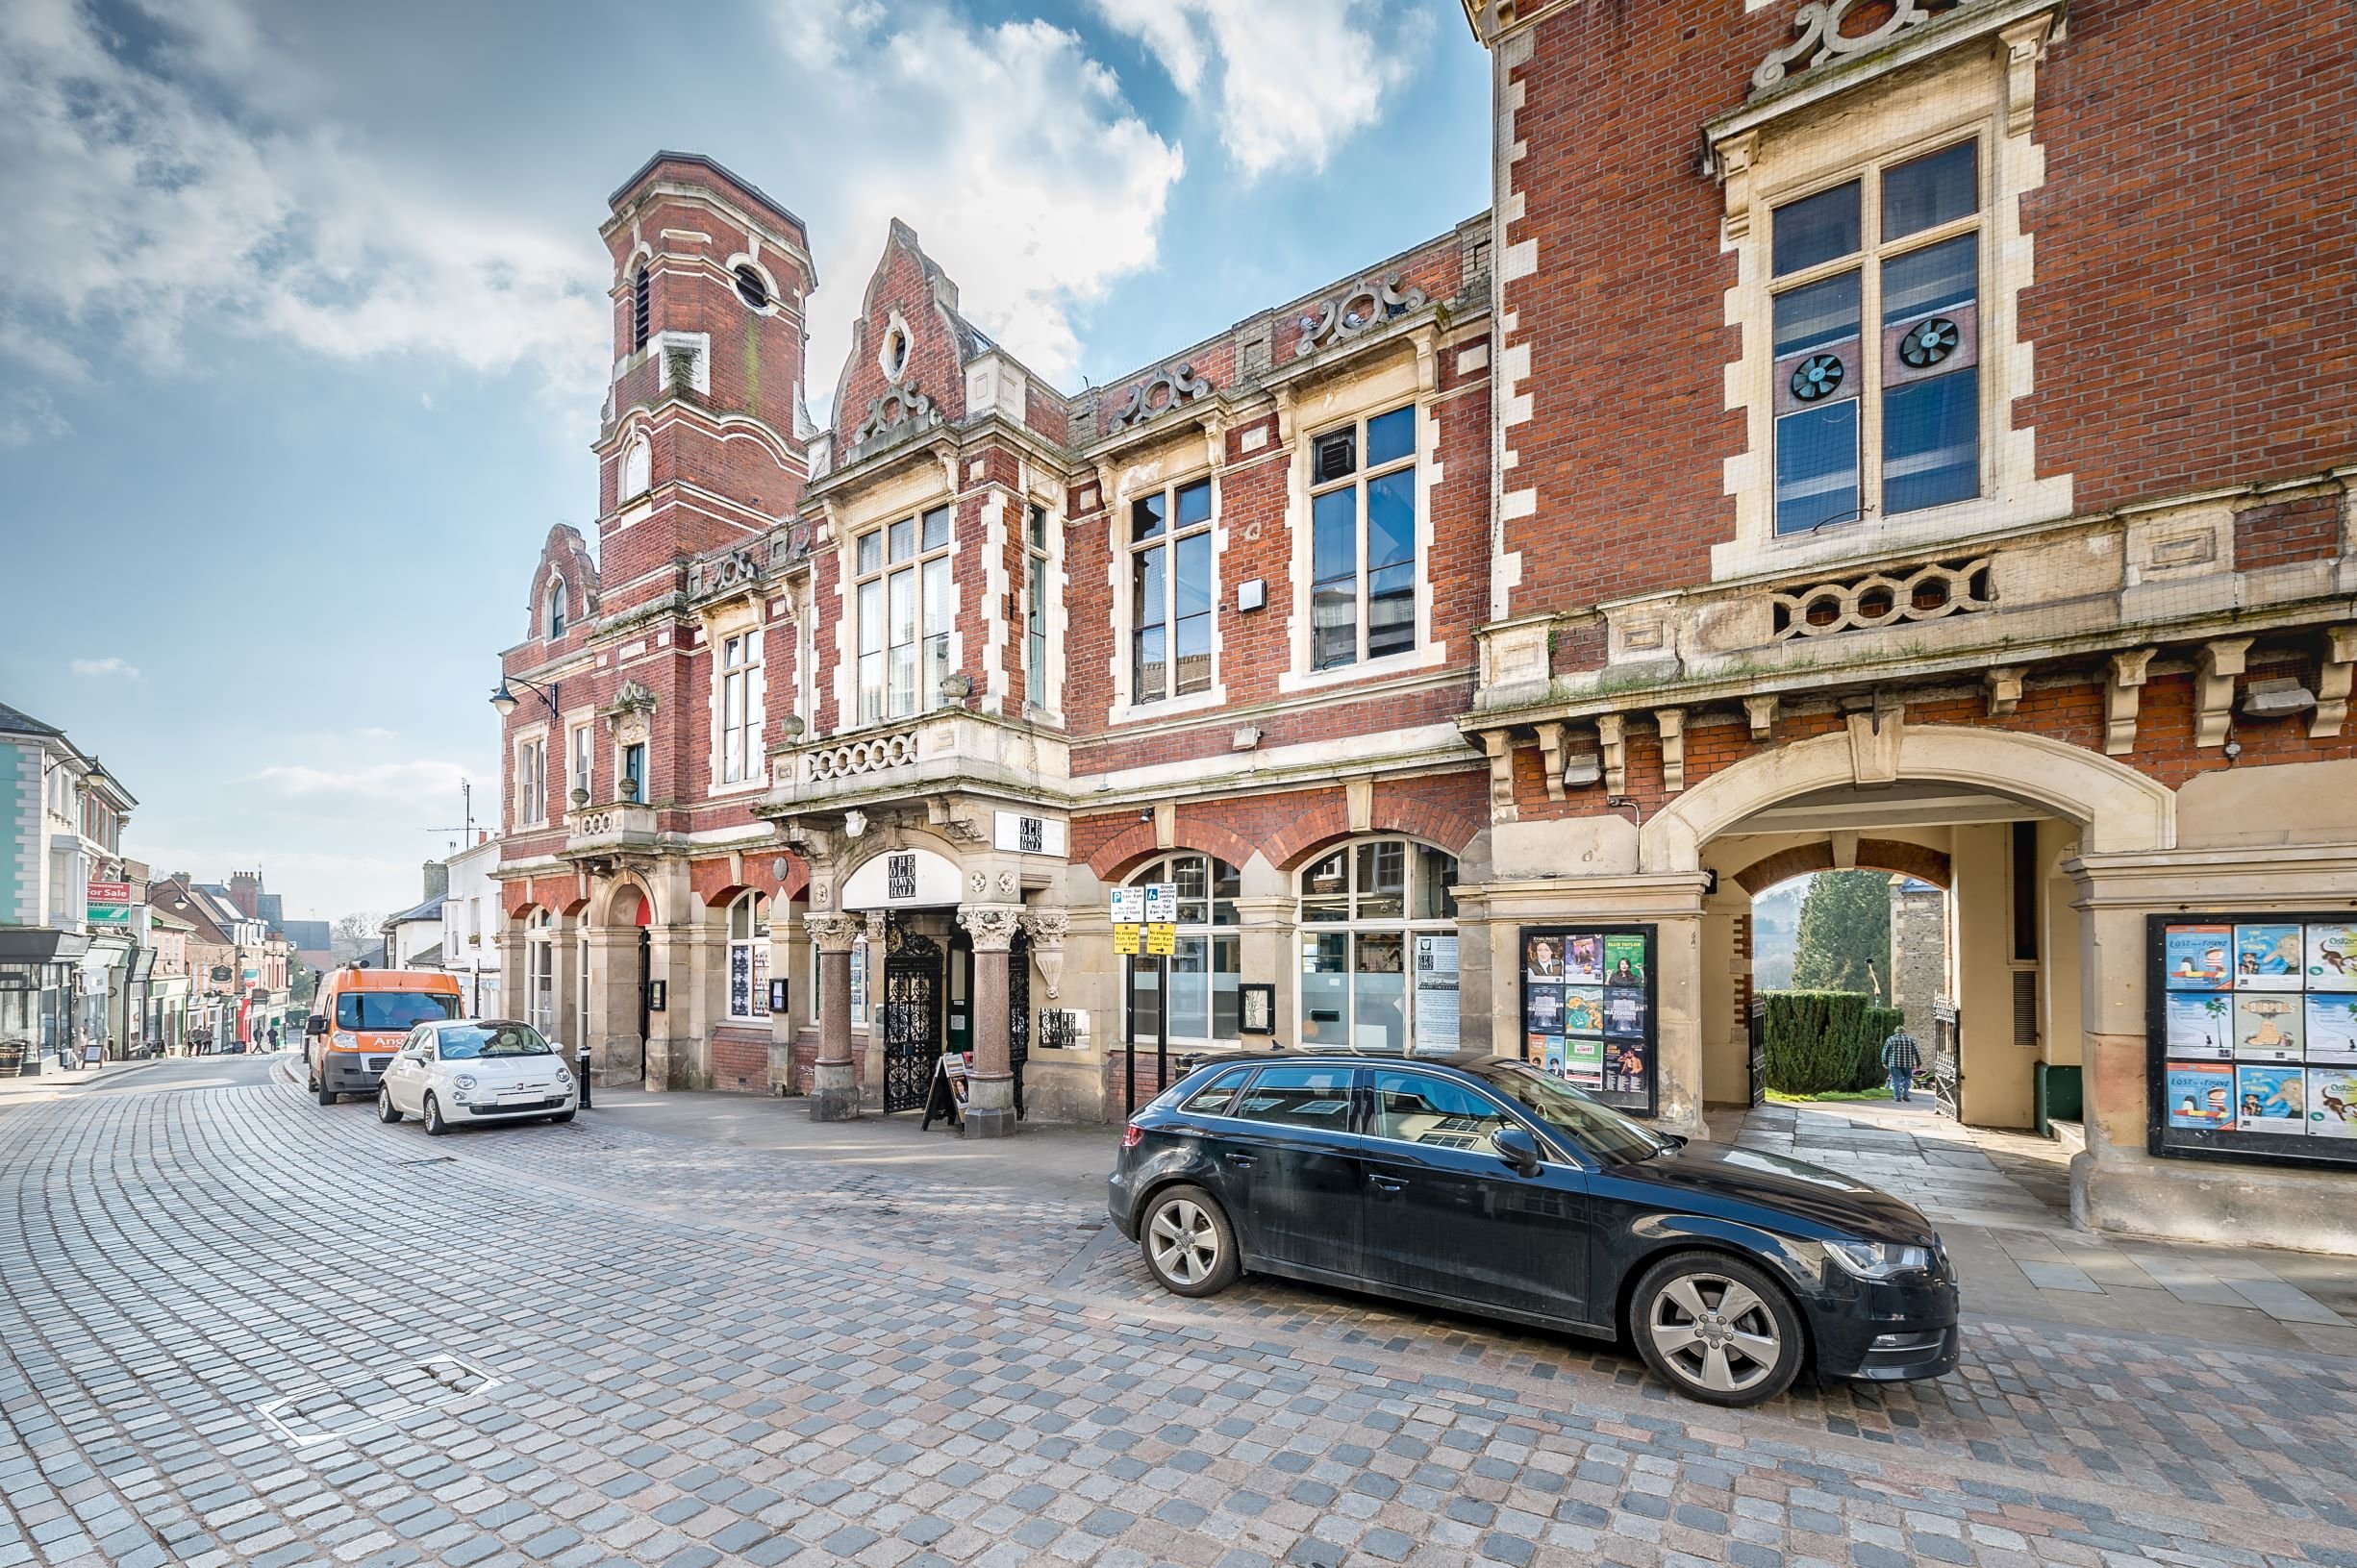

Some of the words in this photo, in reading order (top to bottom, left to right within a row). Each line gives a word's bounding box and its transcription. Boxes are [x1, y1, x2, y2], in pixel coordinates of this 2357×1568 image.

[1020, 818, 1041, 828] THE
[1020, 827, 1041, 836] OLD
[1020, 834, 1041, 843] TOWN
[1020, 841, 1041, 851] HALL
[889, 856, 915, 867] THE
[890, 866, 915, 877] OLD
[890, 876, 915, 887] TOWN
[104, 888, 127, 897] Sale
[890, 886, 915, 897] HALL
